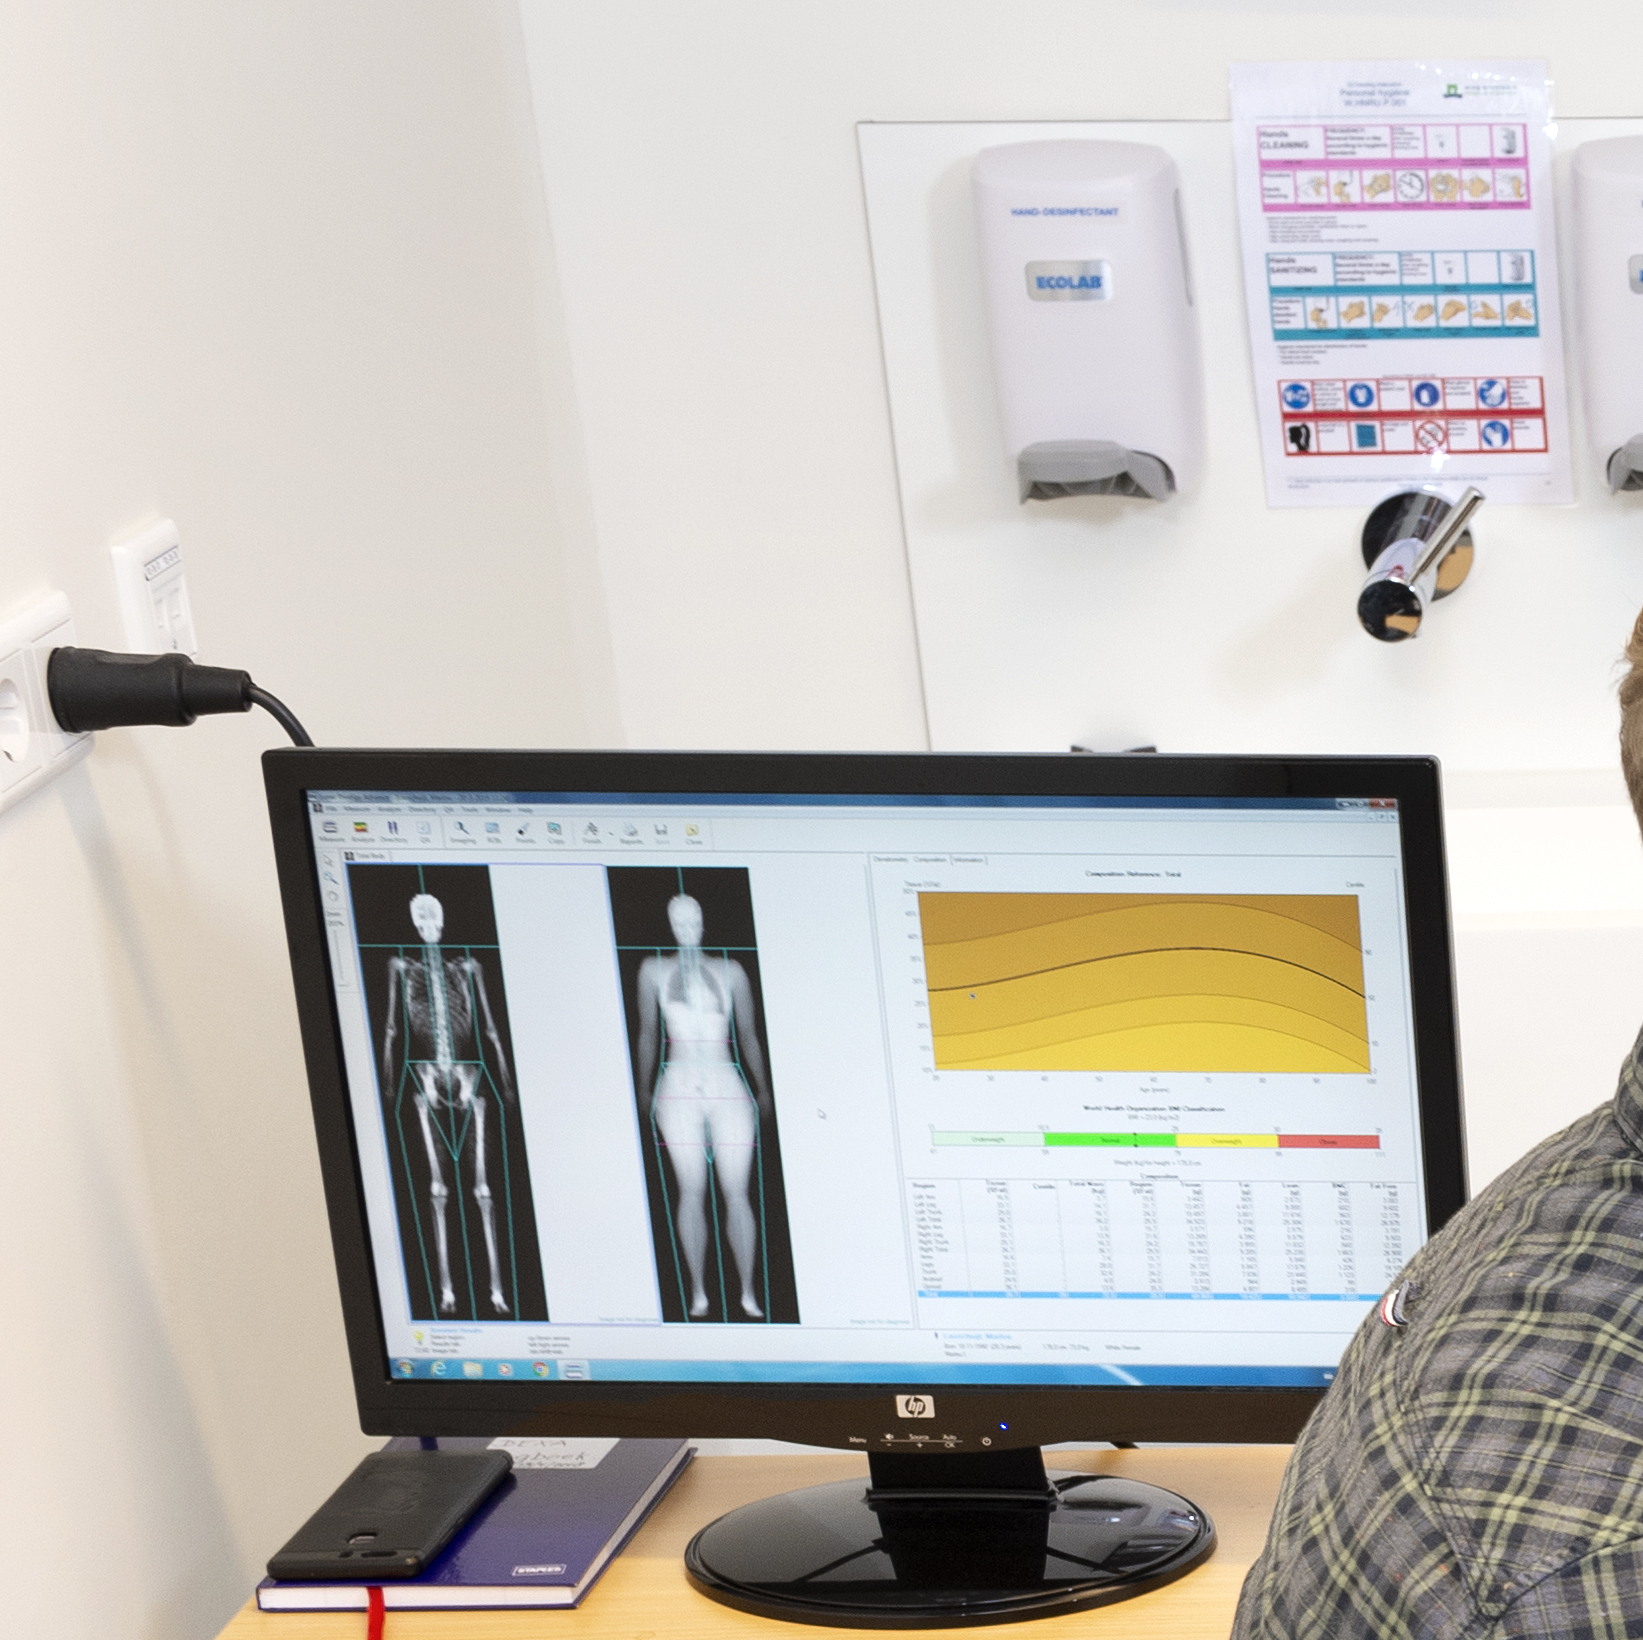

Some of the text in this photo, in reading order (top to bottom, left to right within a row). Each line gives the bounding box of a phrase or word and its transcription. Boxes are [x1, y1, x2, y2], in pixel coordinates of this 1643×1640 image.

[1260, 140, 1309, 150] CLEANING
[1036, 275, 1103, 289] ECOLAB
[905, 1395, 926, 1418] hp
[849, 1436, 867, 1444] Menu
[909, 1433, 930, 1441] Source
[943, 1433, 957, 1441] Auto
[517, 1566, 562, 1574] STAPLES
